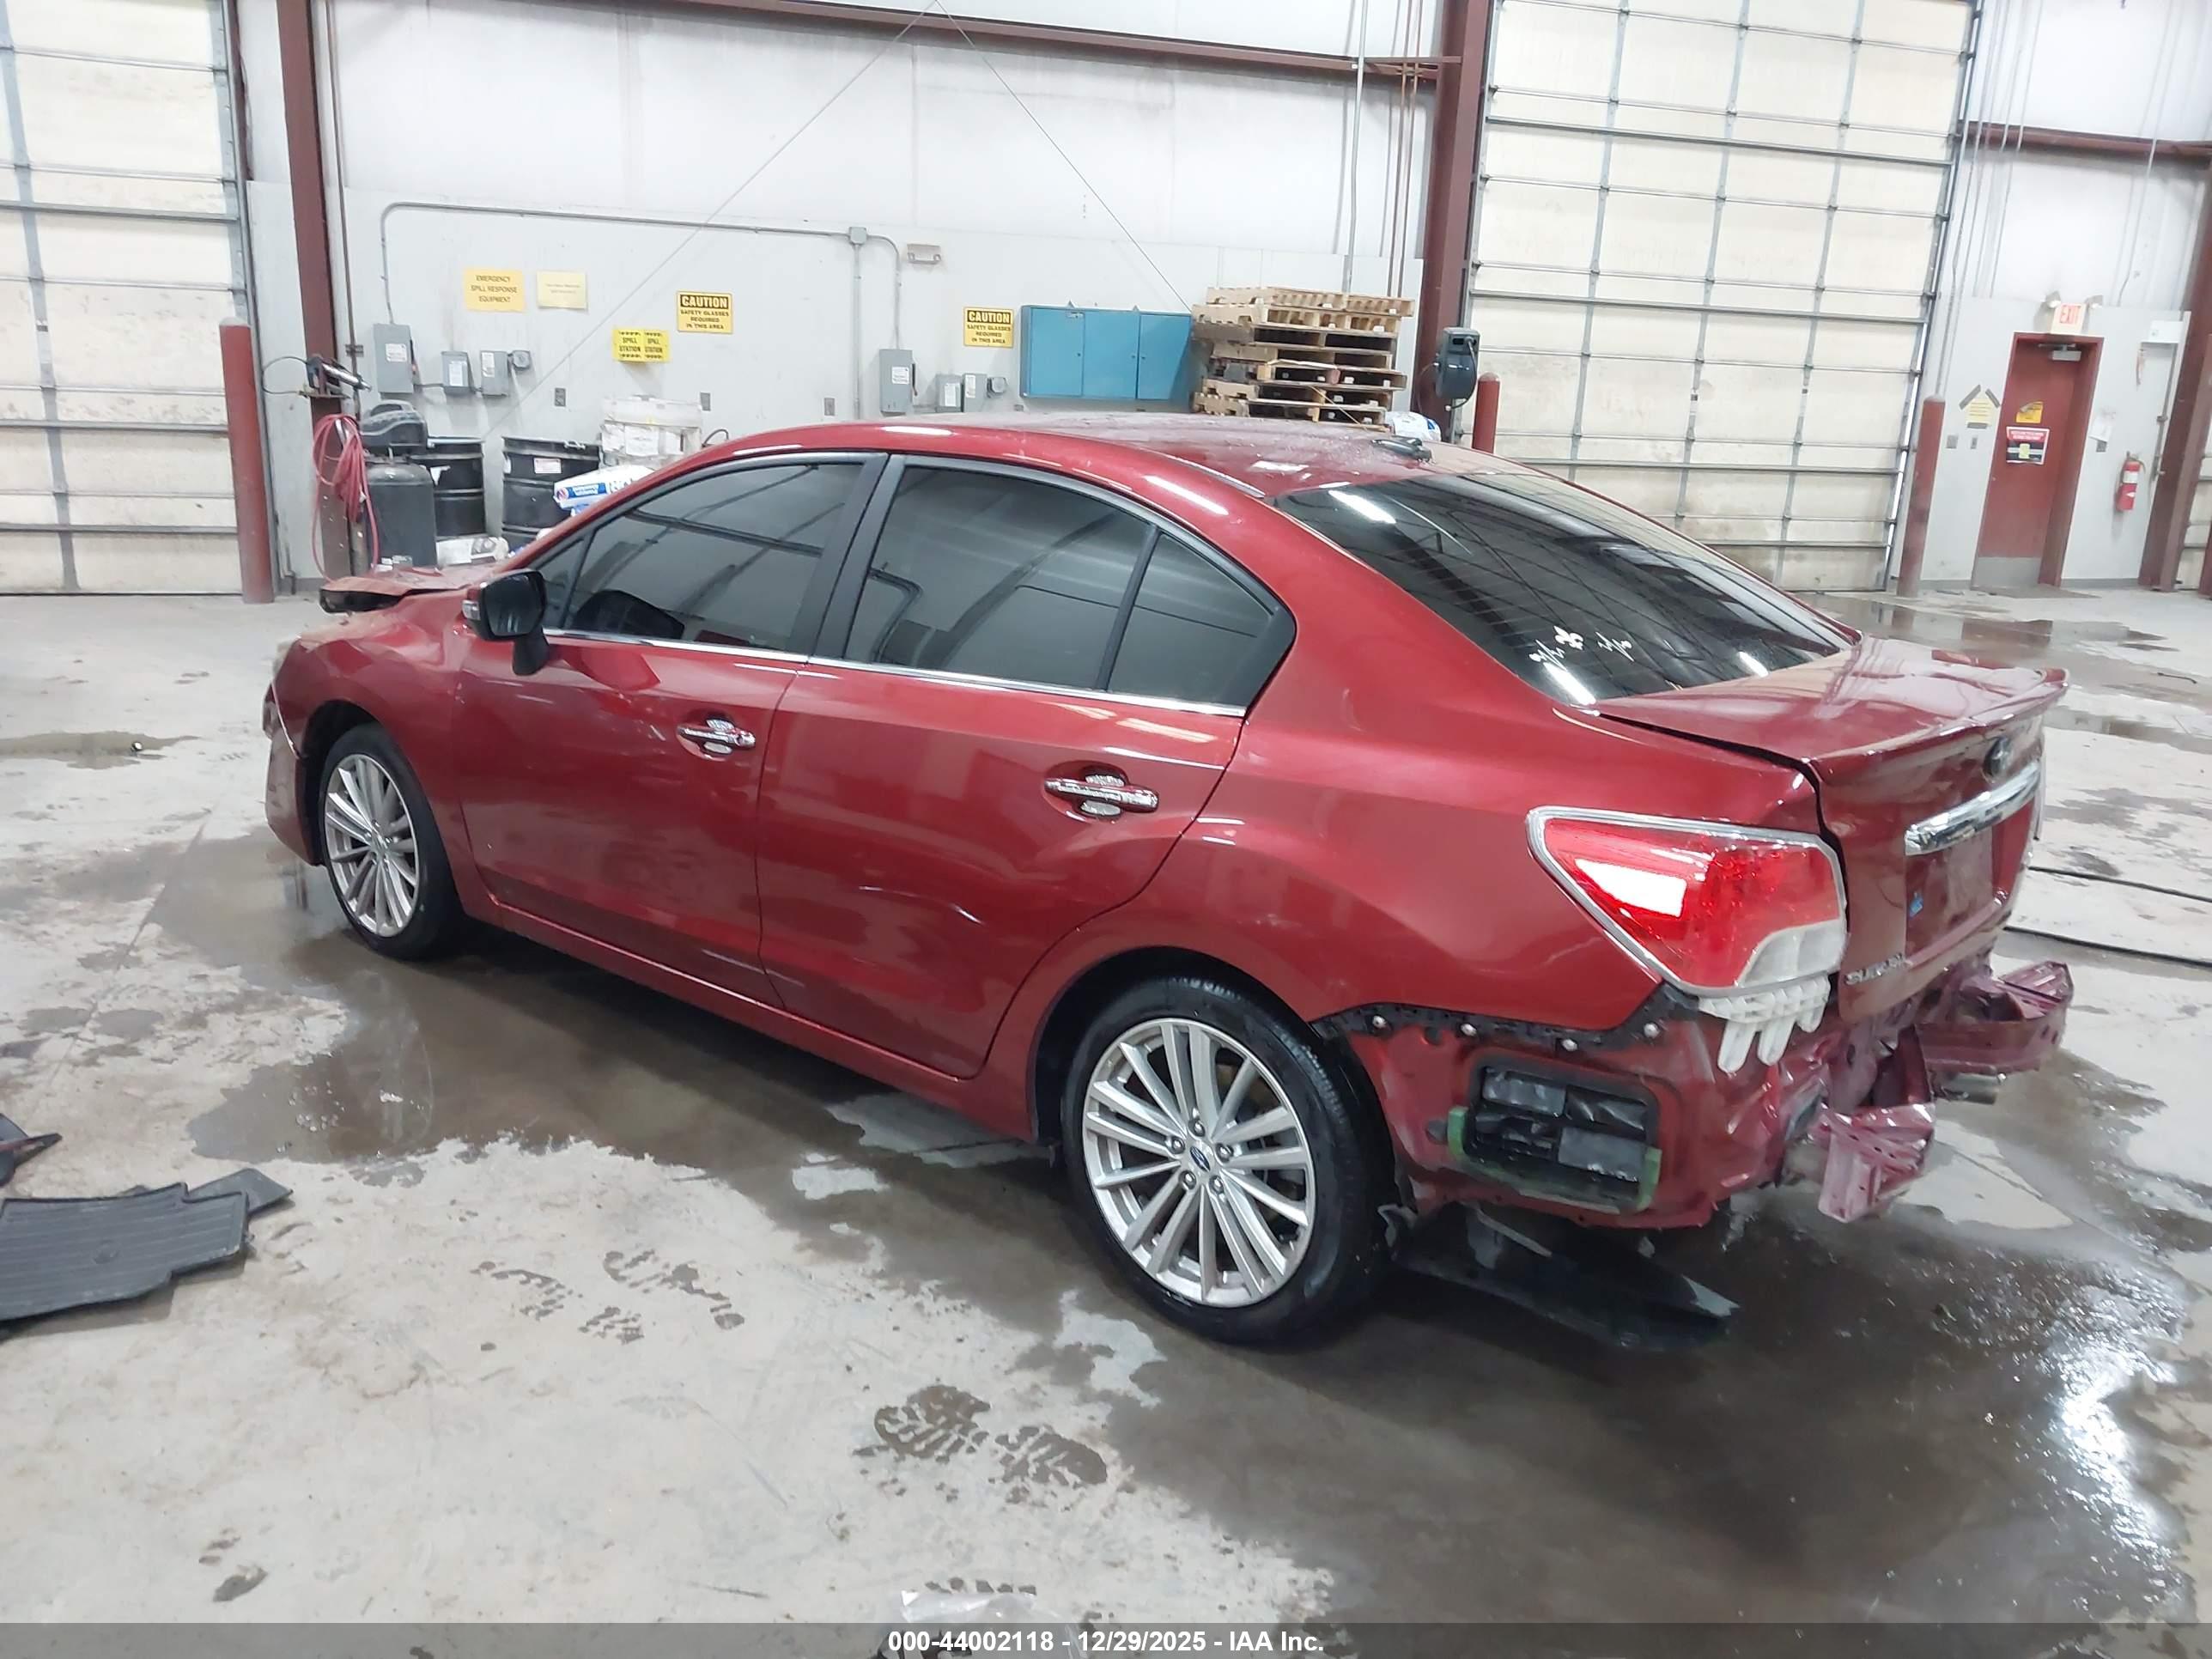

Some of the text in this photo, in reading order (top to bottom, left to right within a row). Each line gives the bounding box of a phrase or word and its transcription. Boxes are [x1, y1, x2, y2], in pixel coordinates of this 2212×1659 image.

[476, 275, 511, 283] EMERGENCY
[487, 285, 518, 294] RESPONSE
[681, 295, 728, 308] CAUTION
[968, 311, 1011, 324] CAUTION
[2059, 304, 2082, 325] EXIT
